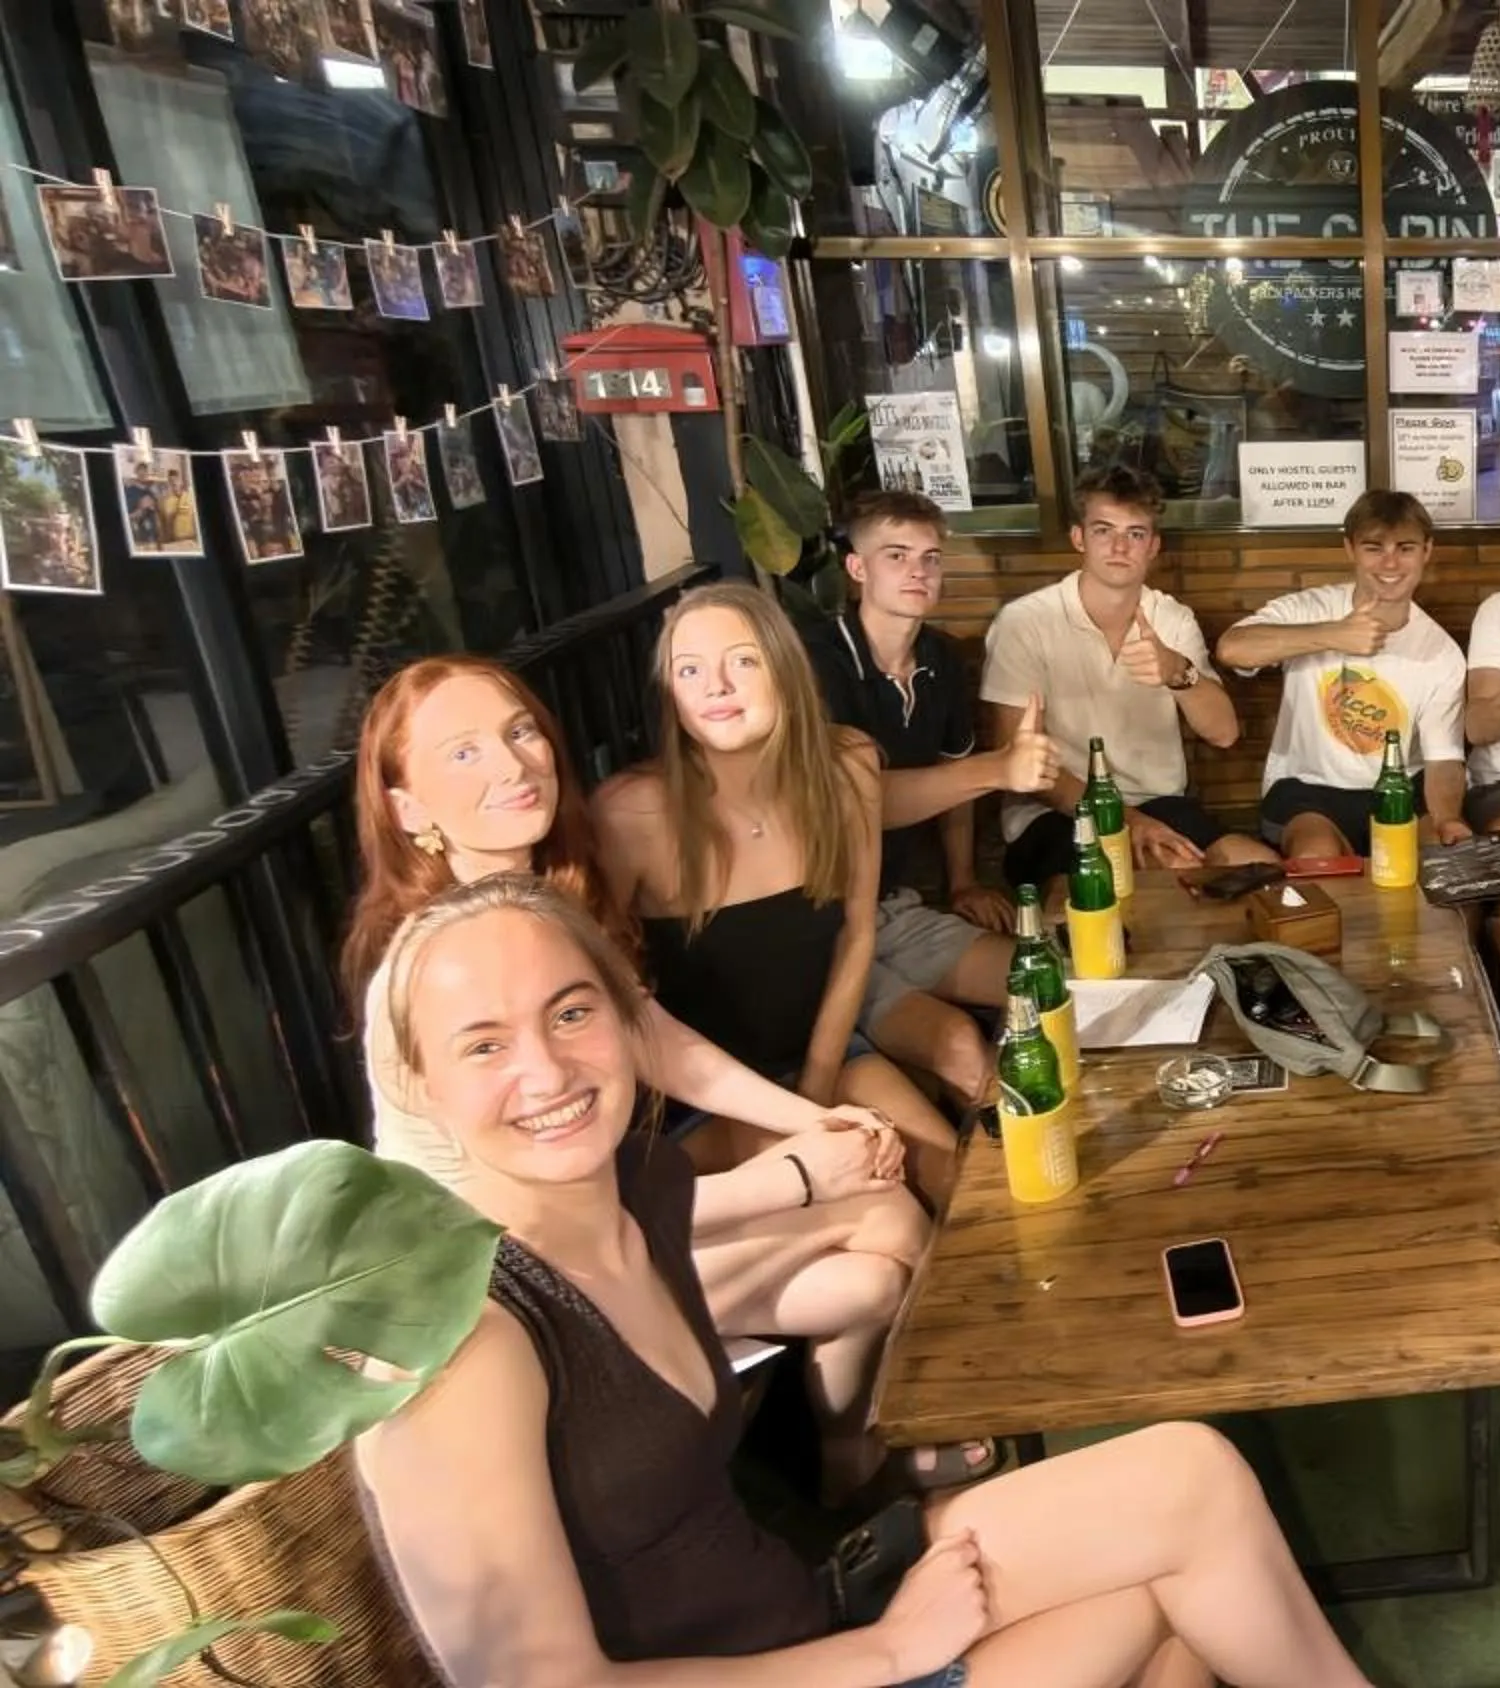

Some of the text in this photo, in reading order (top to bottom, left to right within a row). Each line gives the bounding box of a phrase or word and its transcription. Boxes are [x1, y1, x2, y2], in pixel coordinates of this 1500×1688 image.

[1322, 213, 1486, 269] CBIN
[1250, 285, 1344, 300] ACKPACKERS
[1248, 466, 1276, 475] ONLY
[1279, 466, 1315, 475] HOSTEL
[1261, 482, 1310, 491] ALLOWED
[1312, 482, 1323, 490] IN
[1273, 499, 1304, 507] AFTER
